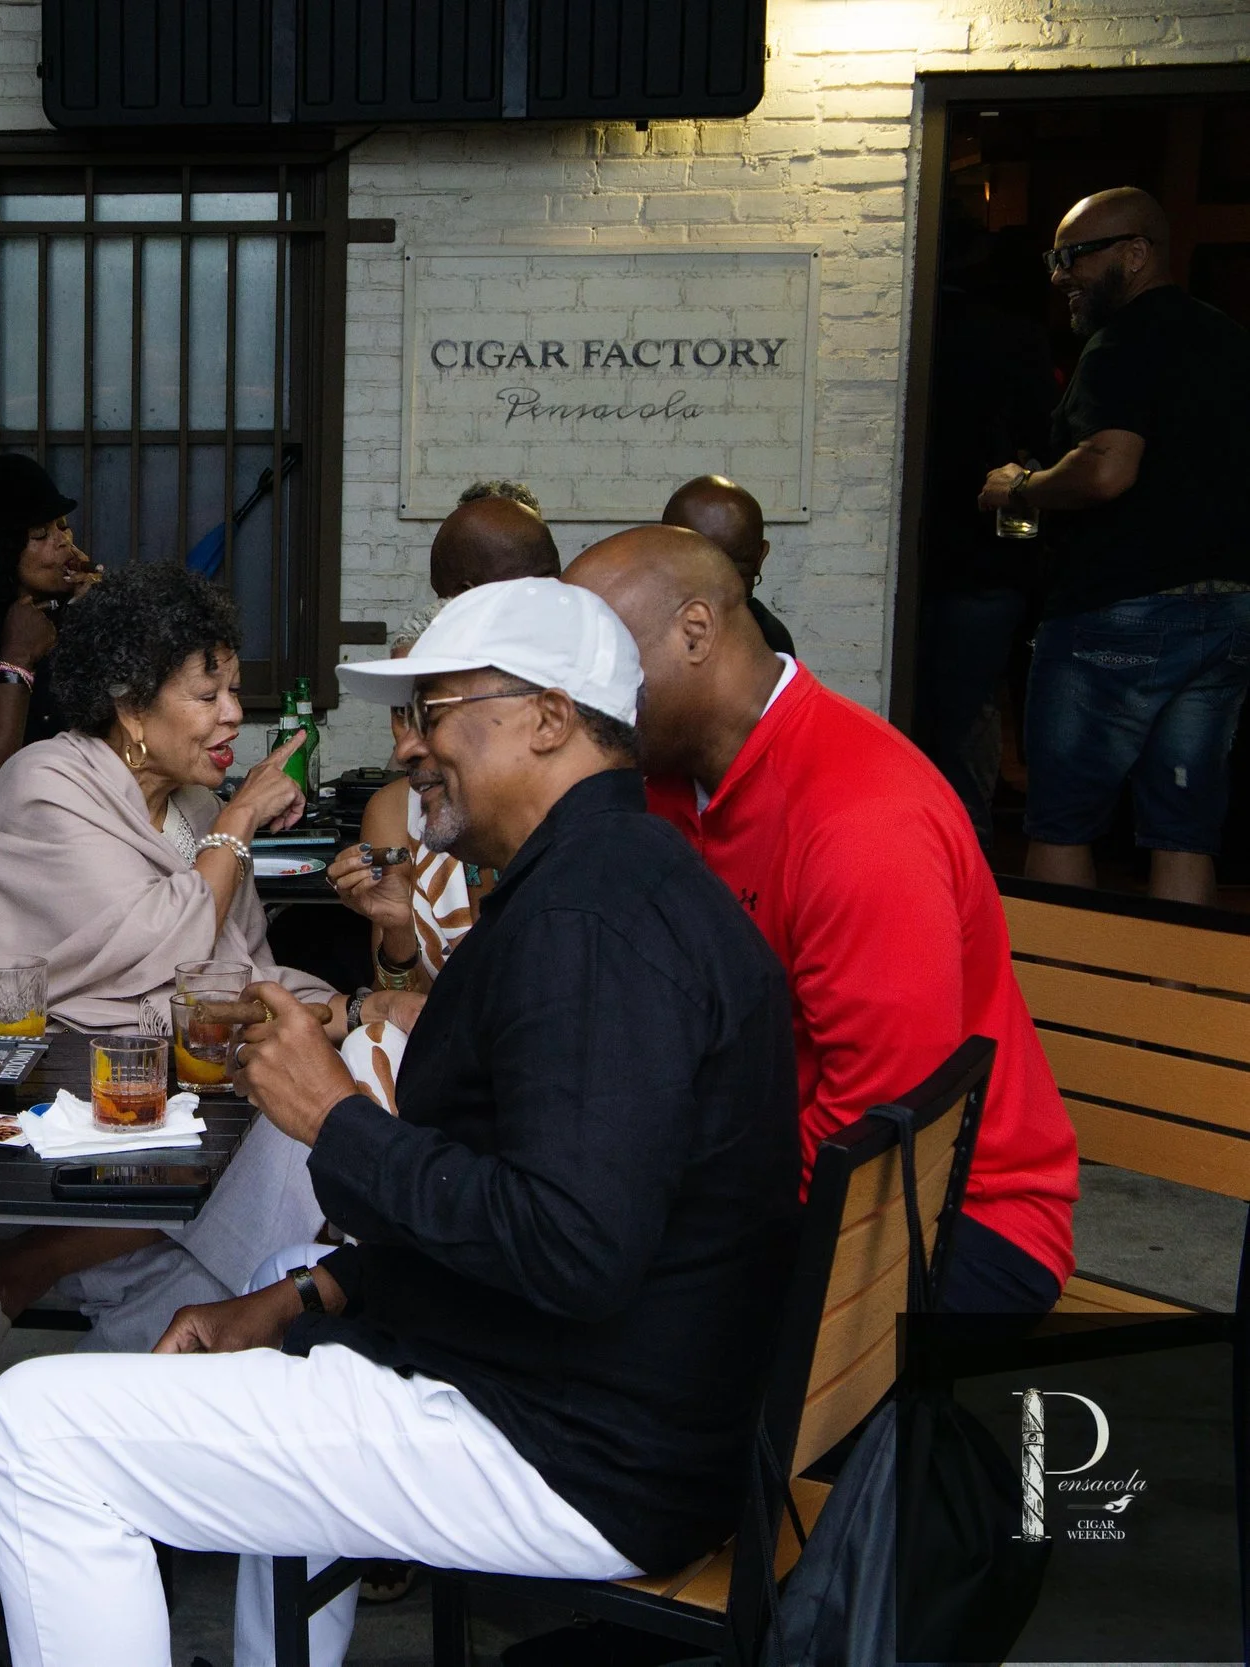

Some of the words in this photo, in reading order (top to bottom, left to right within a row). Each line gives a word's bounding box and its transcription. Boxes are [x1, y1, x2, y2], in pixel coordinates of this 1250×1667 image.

[431, 339, 569, 369] CIGAR
[582, 338, 787, 368] FACTORY
[496, 386, 704, 426] Pensacola
